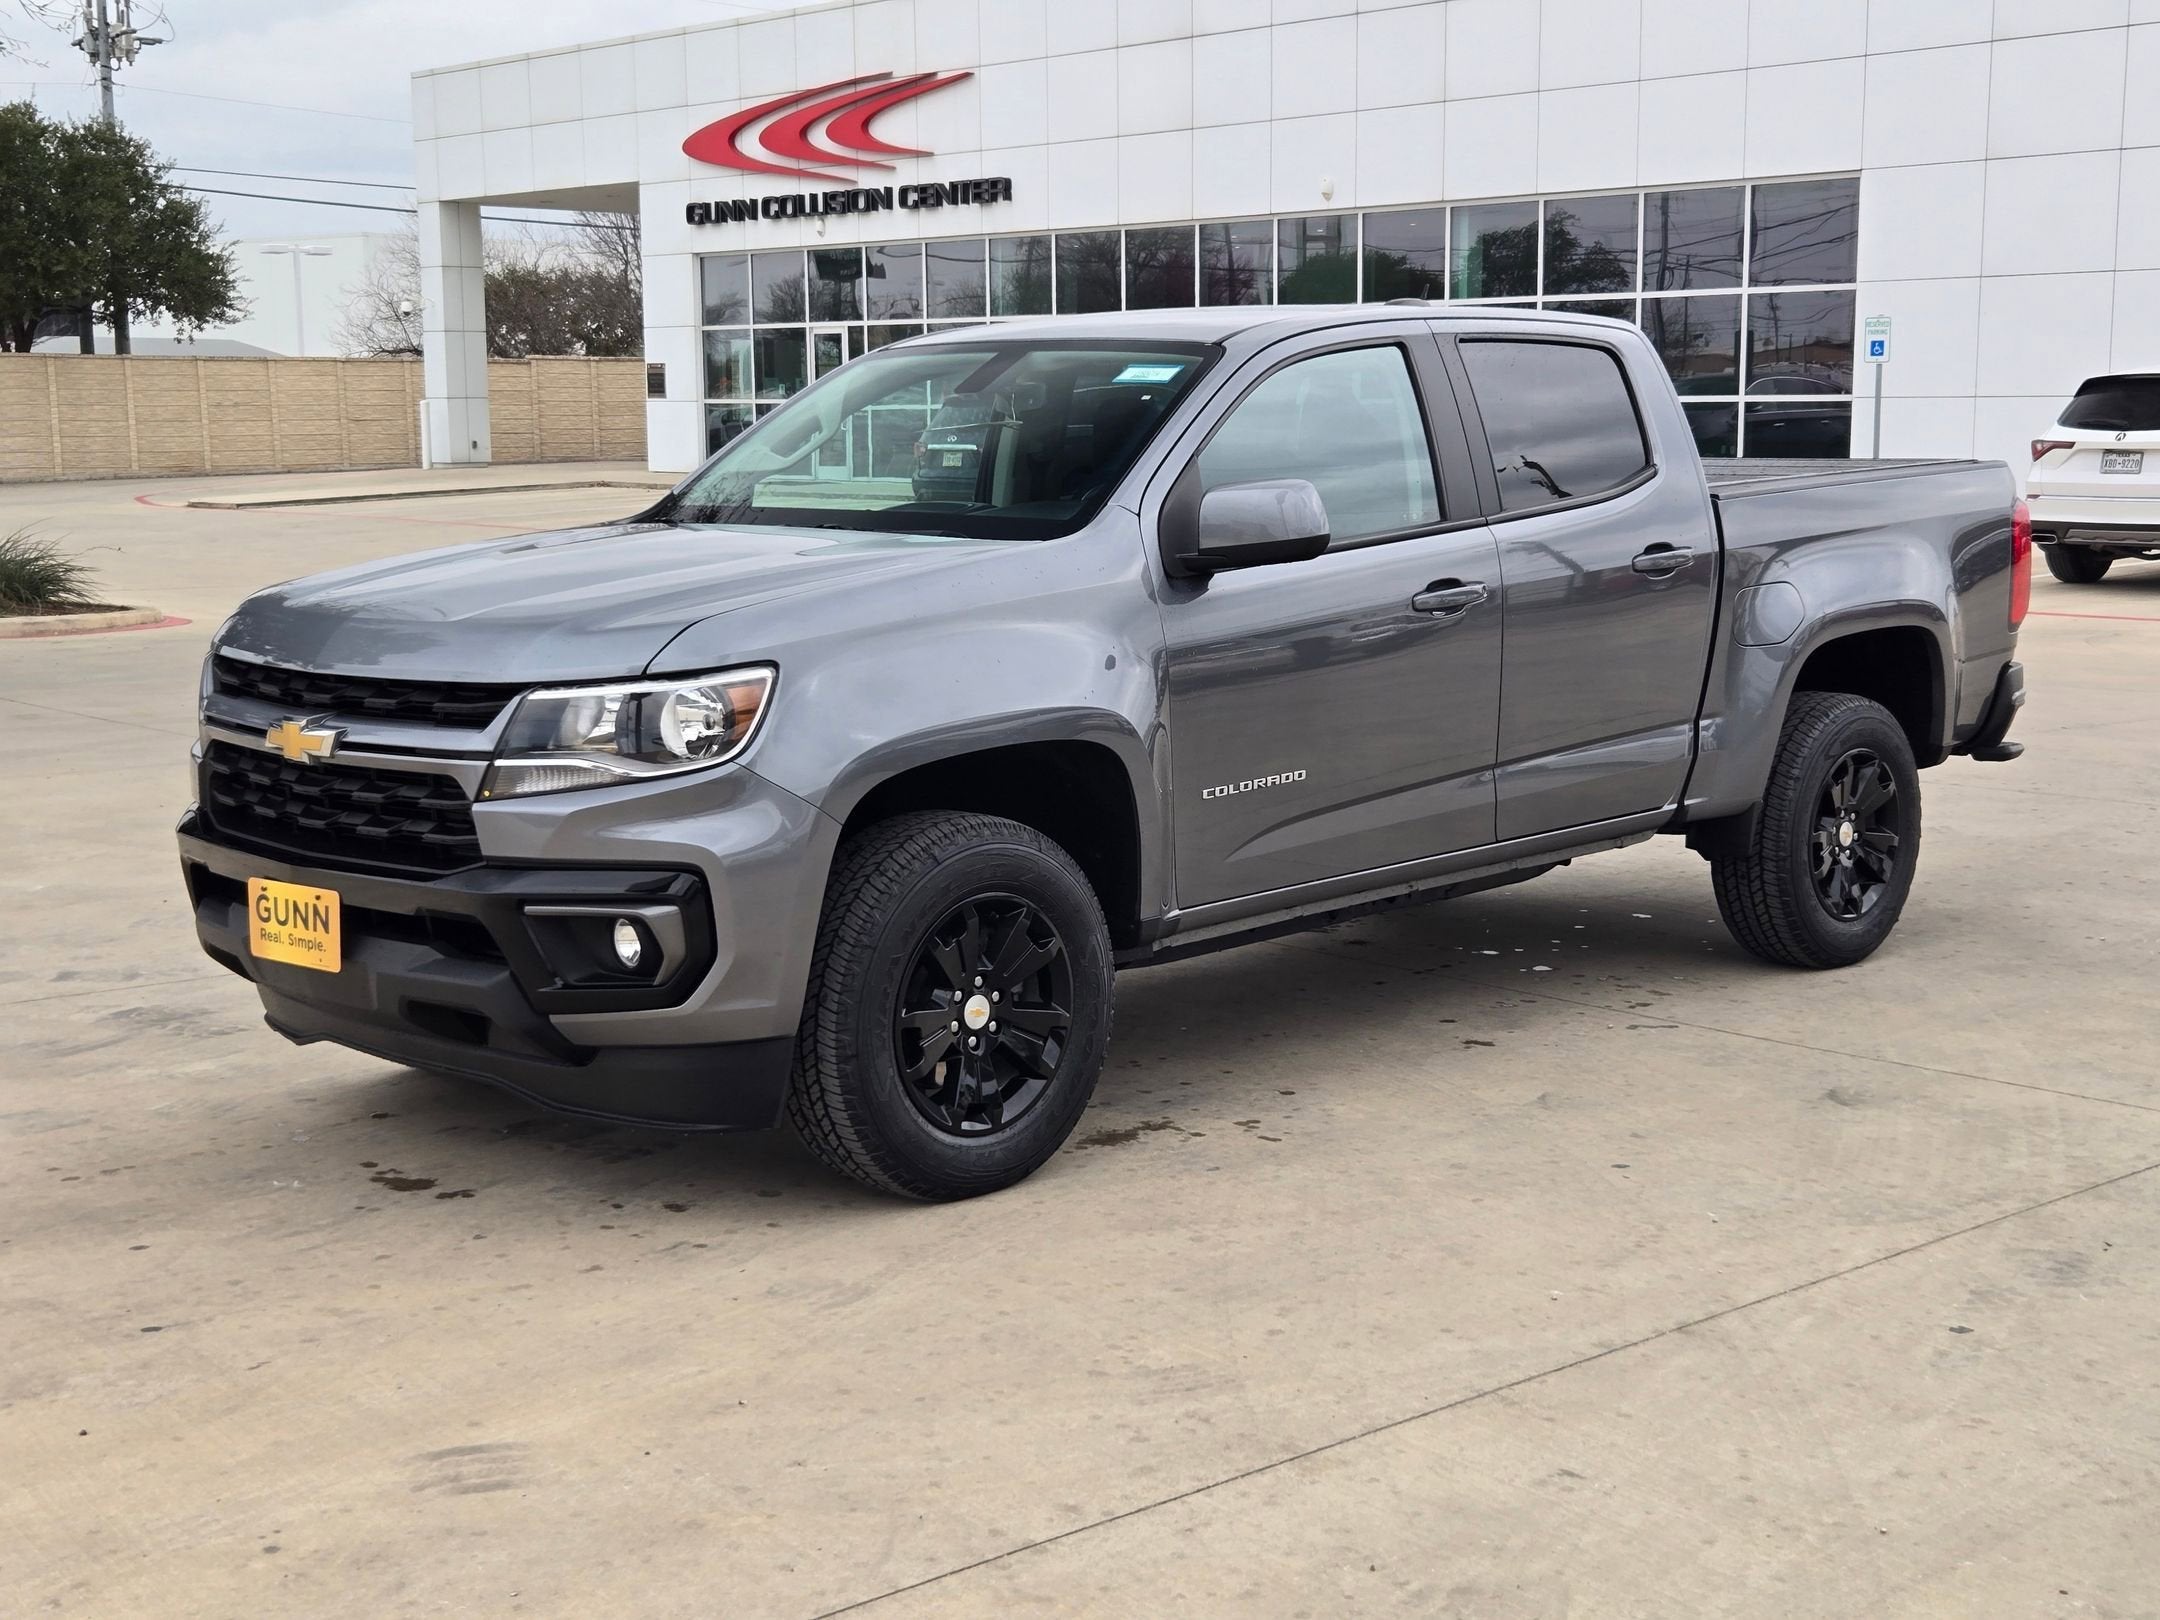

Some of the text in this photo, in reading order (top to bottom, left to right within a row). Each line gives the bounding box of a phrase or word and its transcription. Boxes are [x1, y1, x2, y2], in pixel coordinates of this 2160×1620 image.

[686, 177, 1013, 225] GUNN COLLISION CENTER
[1202, 769, 1307, 800] COLORADO
[256, 894, 330, 934] GUNN
[260, 927, 326, 953] Real. Simple.
